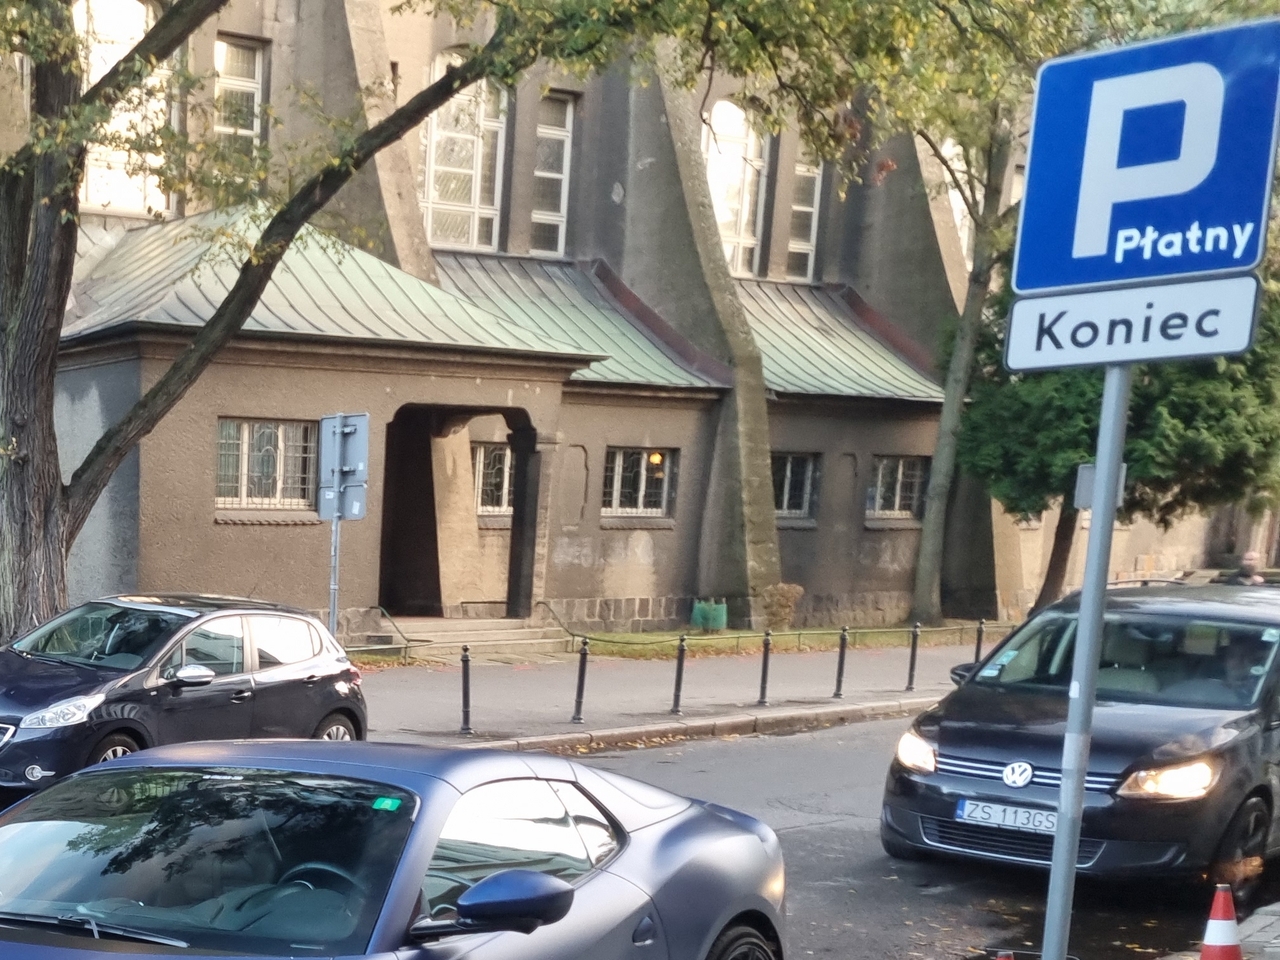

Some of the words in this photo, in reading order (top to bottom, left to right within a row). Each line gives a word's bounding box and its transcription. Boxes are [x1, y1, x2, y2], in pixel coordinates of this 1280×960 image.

[1072, 62, 1225, 259] P
[1115, 221, 1254, 263] Płatny
[1035, 302, 1220, 351] Koniec
[967, 802, 993, 820] ZS
[1001, 808, 1056, 829] 113GS
